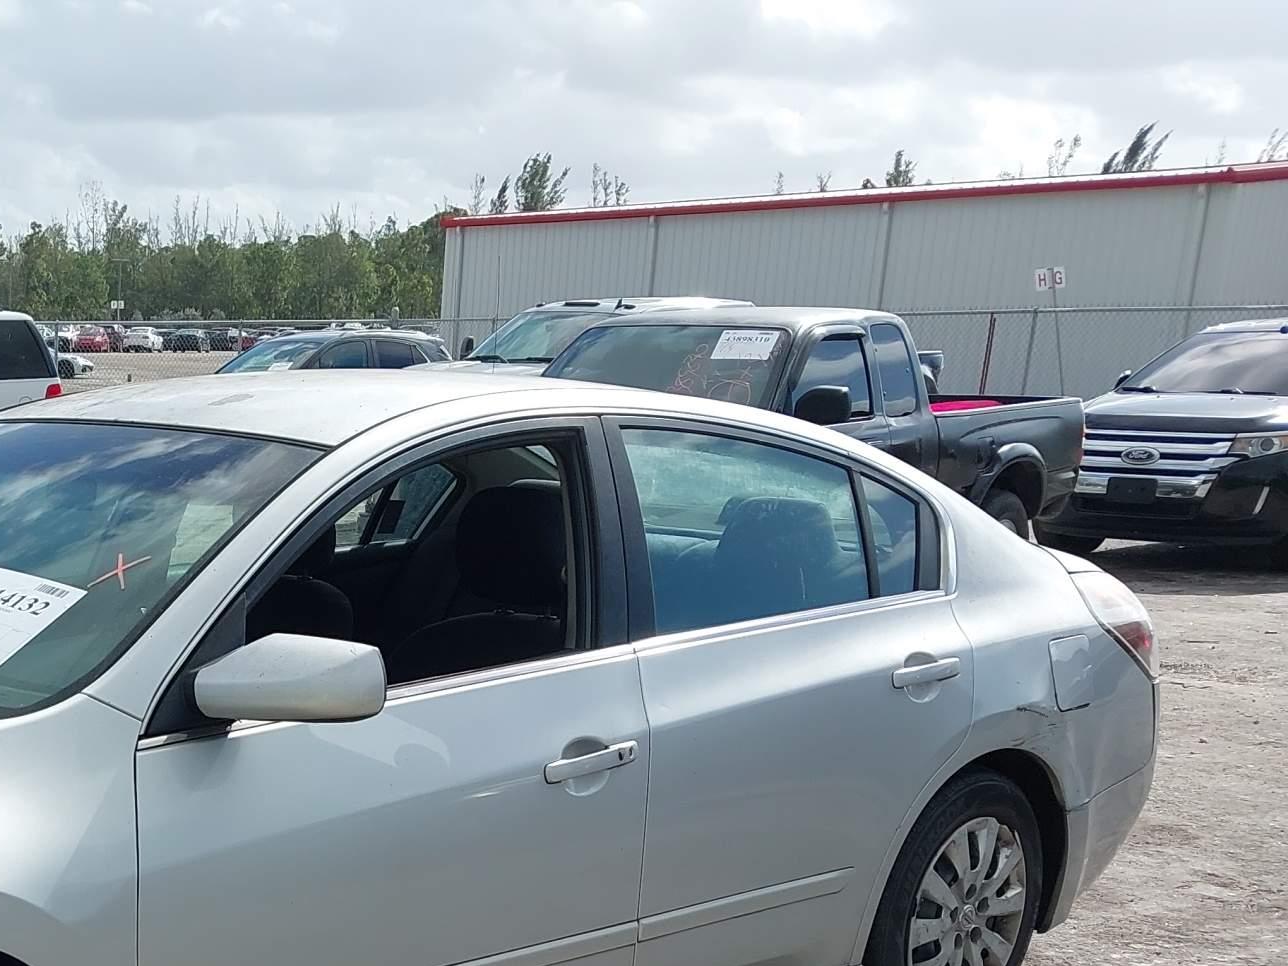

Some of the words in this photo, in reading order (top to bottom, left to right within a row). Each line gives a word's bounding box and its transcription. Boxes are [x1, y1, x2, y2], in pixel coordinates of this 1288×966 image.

[1038, 272, 1047, 288] H
[1054, 270, 1063, 285] G
[1128, 449, 1150, 459] Ford
